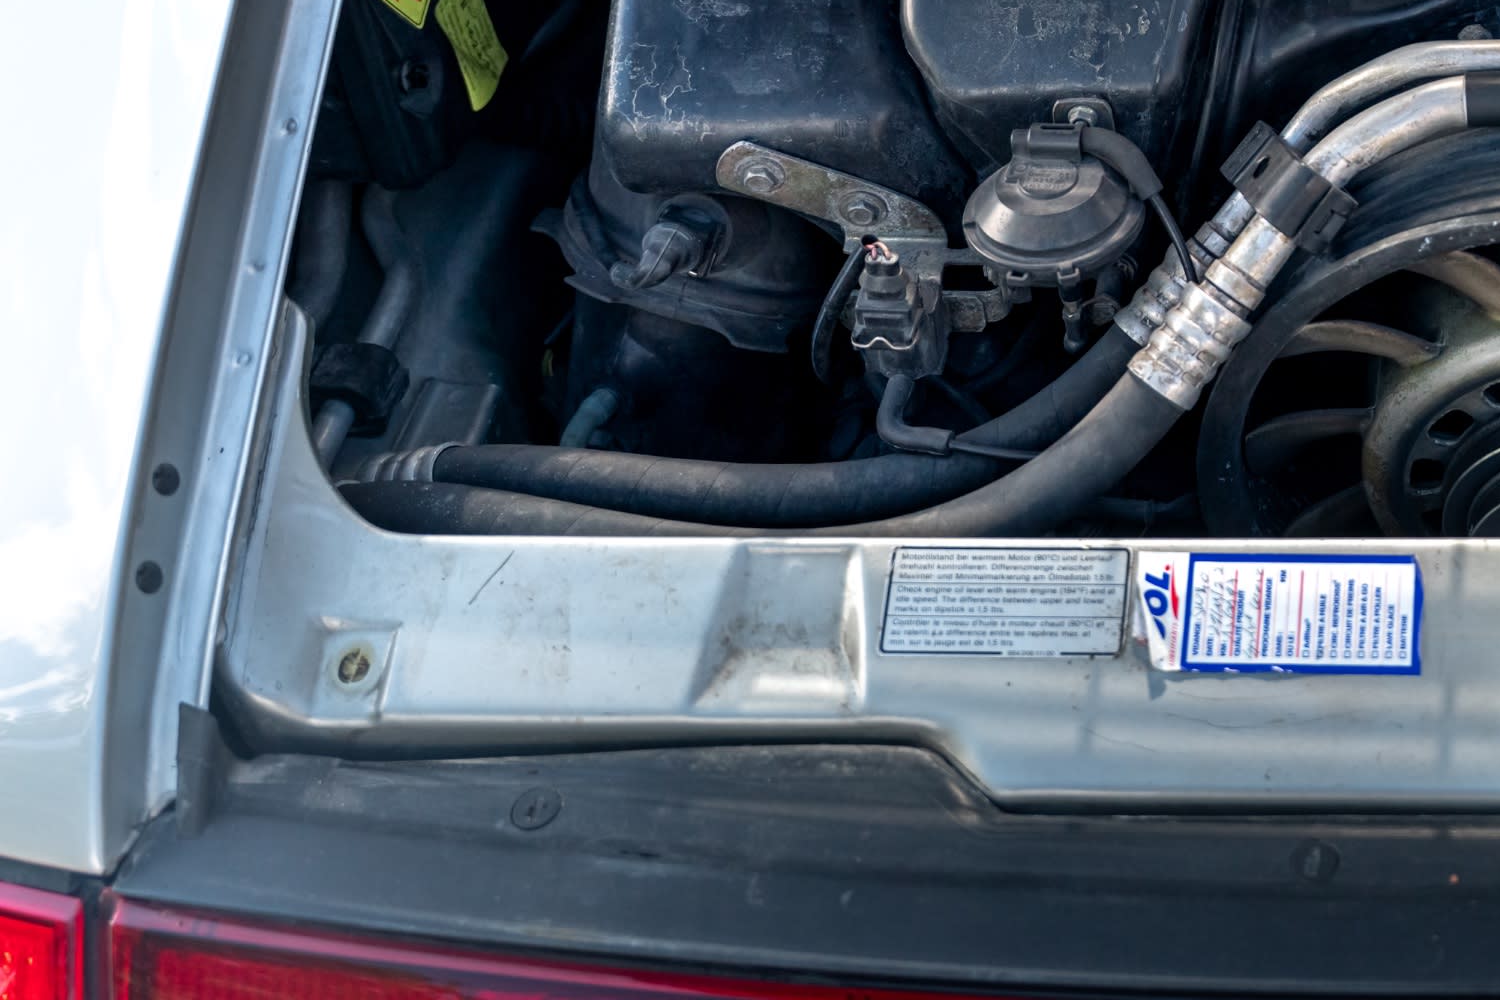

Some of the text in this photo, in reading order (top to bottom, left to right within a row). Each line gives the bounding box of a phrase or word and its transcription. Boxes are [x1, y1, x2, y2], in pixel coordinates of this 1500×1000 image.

[897, 585, 923, 593] Check
[925, 586, 952, 594] engine
[1374, 586, 1382, 615] POLLEN
[1236, 589, 1245, 623] PRODUIT
[1260, 577, 1272, 656] PROCHAINE VIDANGE
[1318, 593, 1326, 615] HUILE
[1344, 578, 1355, 648] CIRCUIT DE FREINS
[1358, 625, 1366, 648] FILTRE
[1372, 625, 1380, 649] FILTRE
[1385, 631, 1393, 649] LAVE
[1399, 614, 1408, 649] BATTERIE
